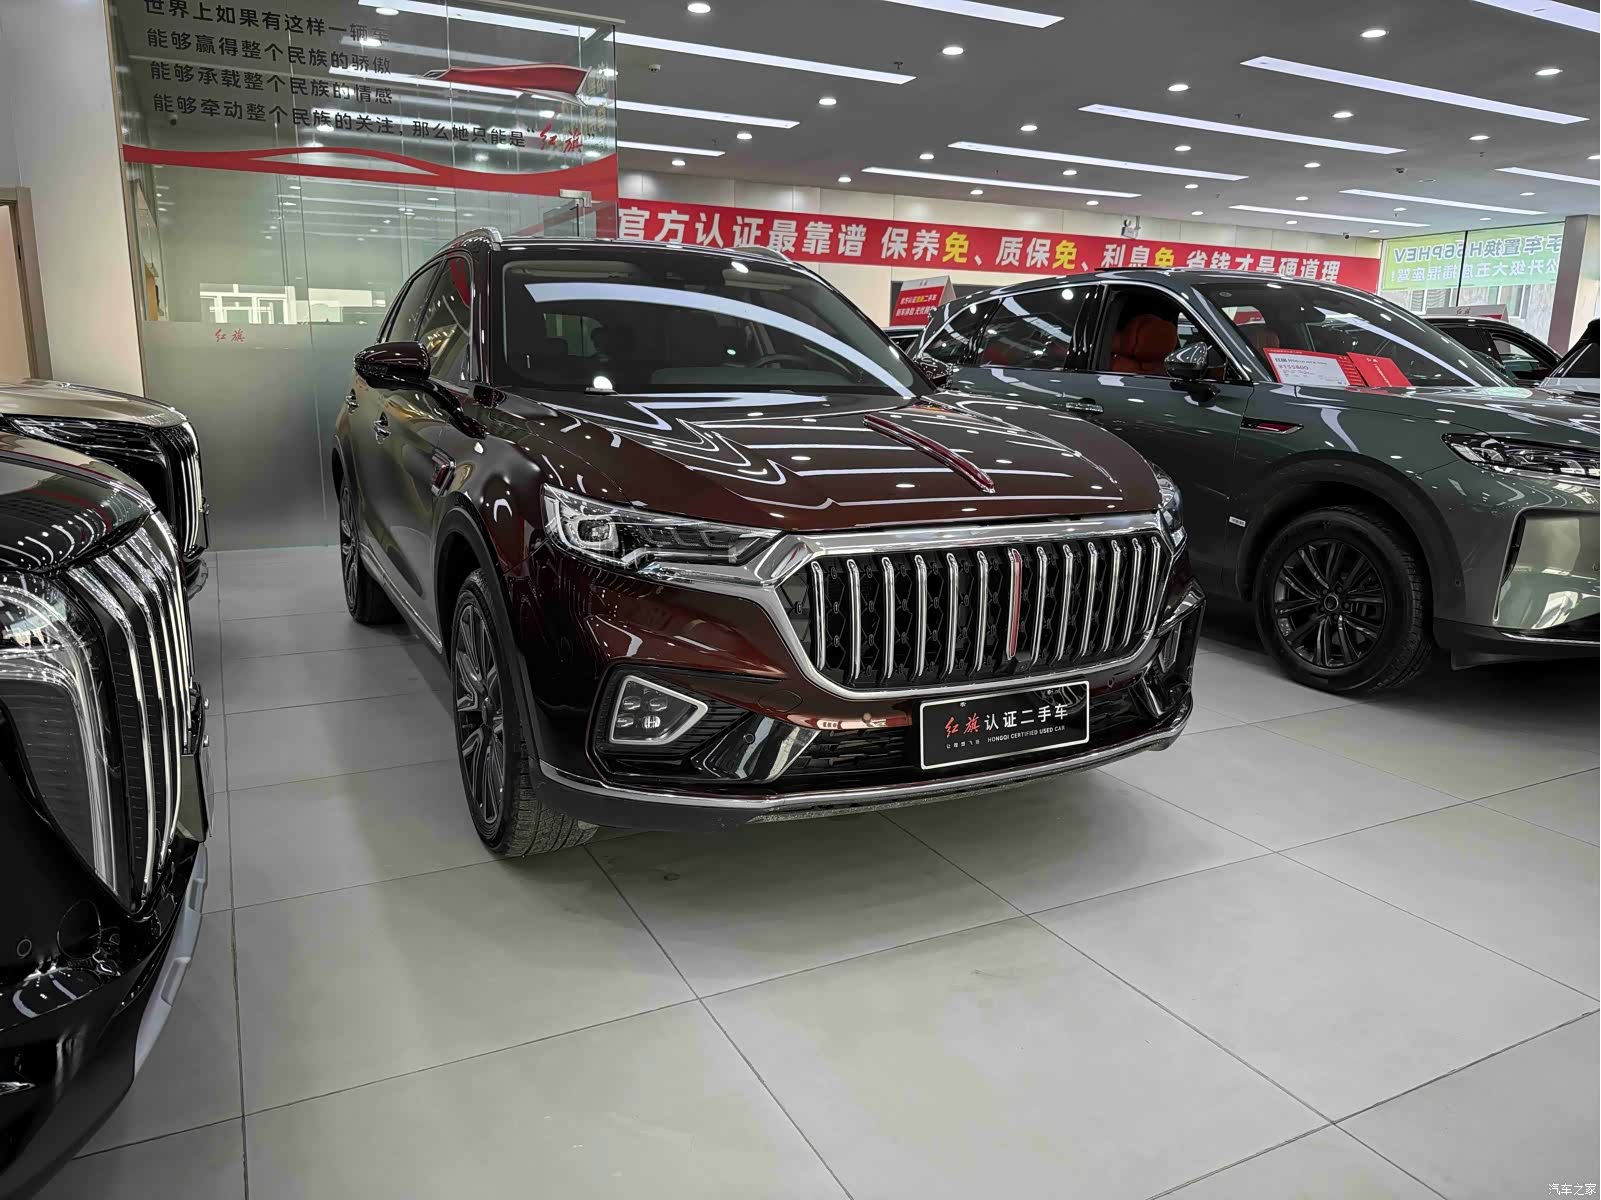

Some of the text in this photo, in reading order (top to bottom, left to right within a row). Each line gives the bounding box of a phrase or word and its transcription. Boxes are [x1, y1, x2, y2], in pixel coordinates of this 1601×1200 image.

[147, 28, 391, 74] 能够赢得整个民族的骄傲
[150, 61, 393, 104] 能够承载整个民族的情感
[618, 206, 867, 257] 官方认证最靠谱
[1186, 249, 1340, 284] 省钱才是硬道理
[987, 734, 1009, 743] HONGQI
[1011, 730, 1038, 739] CERTIFIED
